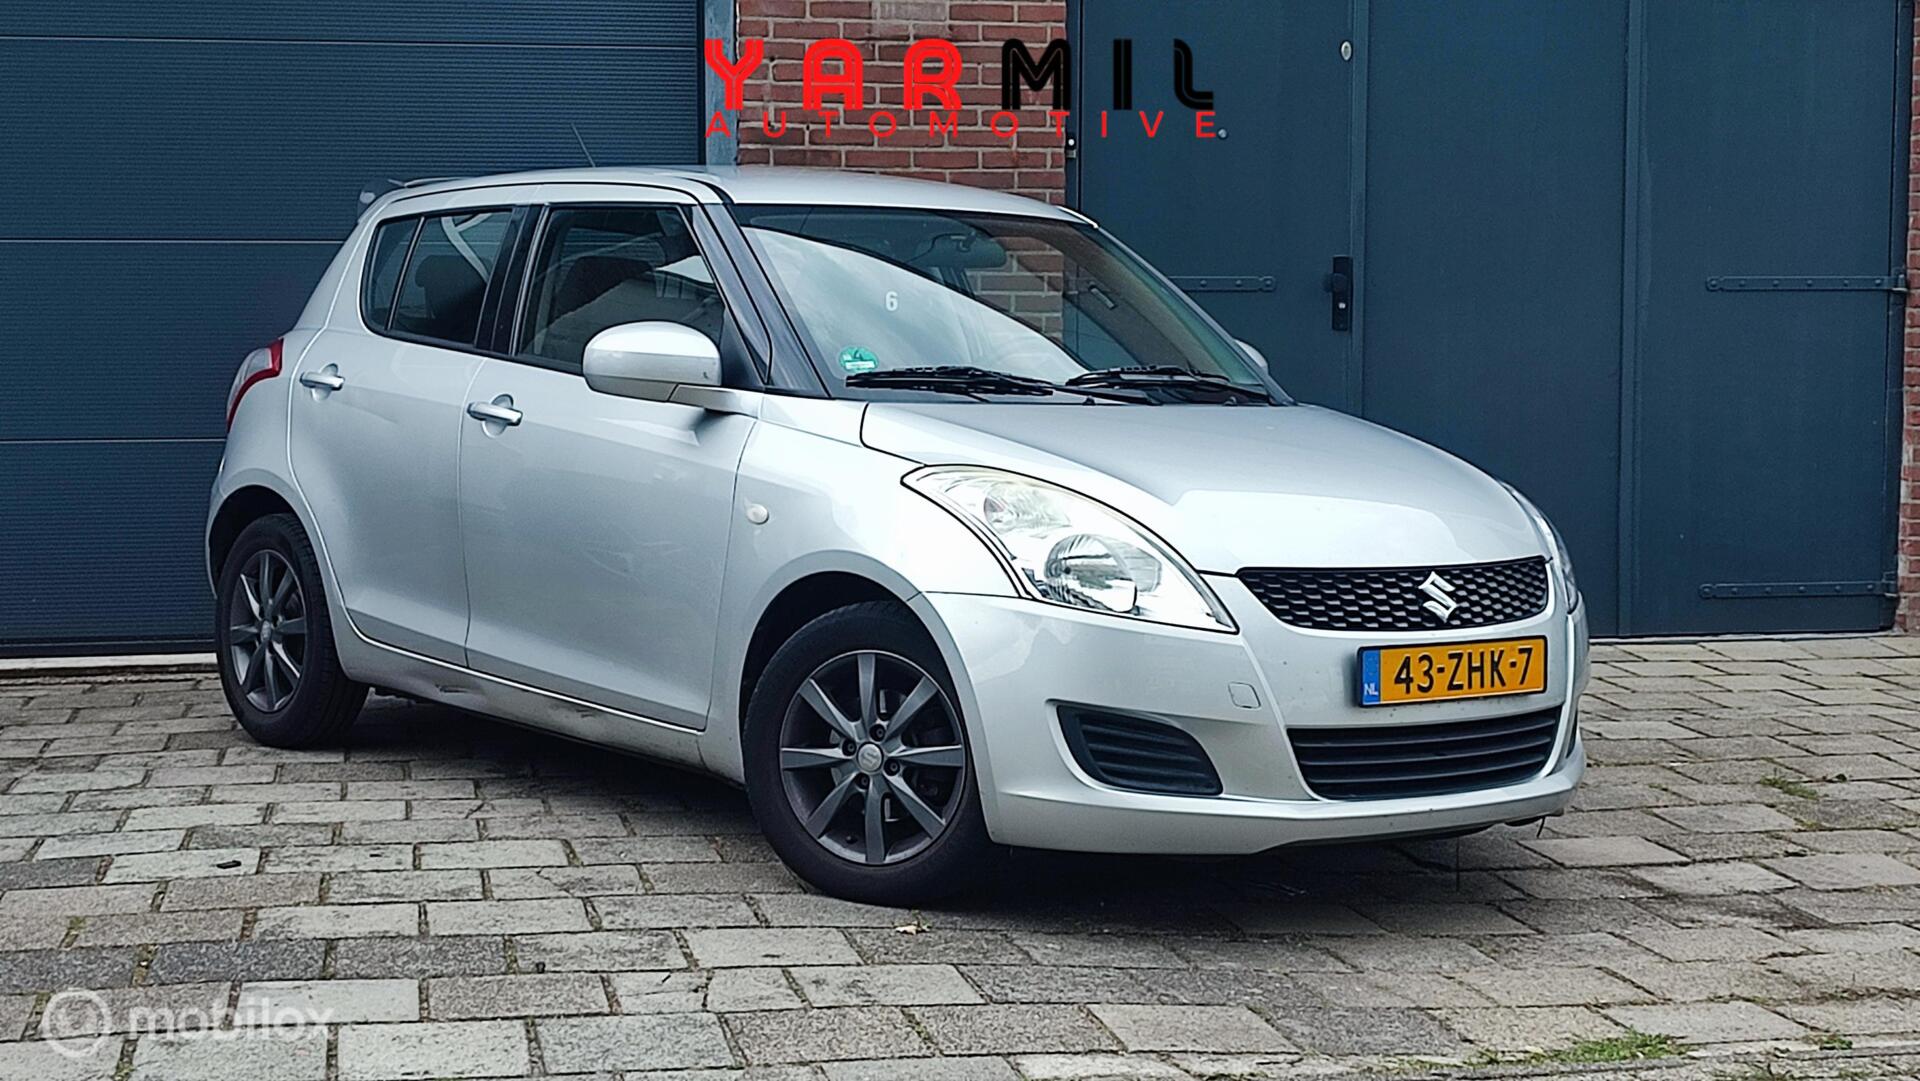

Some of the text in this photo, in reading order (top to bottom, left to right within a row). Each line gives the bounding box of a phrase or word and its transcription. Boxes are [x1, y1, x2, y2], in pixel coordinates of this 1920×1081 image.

[885, 290, 899, 312] 6
[1394, 646, 1534, 694] 43-ZHK-7
[1363, 683, 1379, 696] NL
